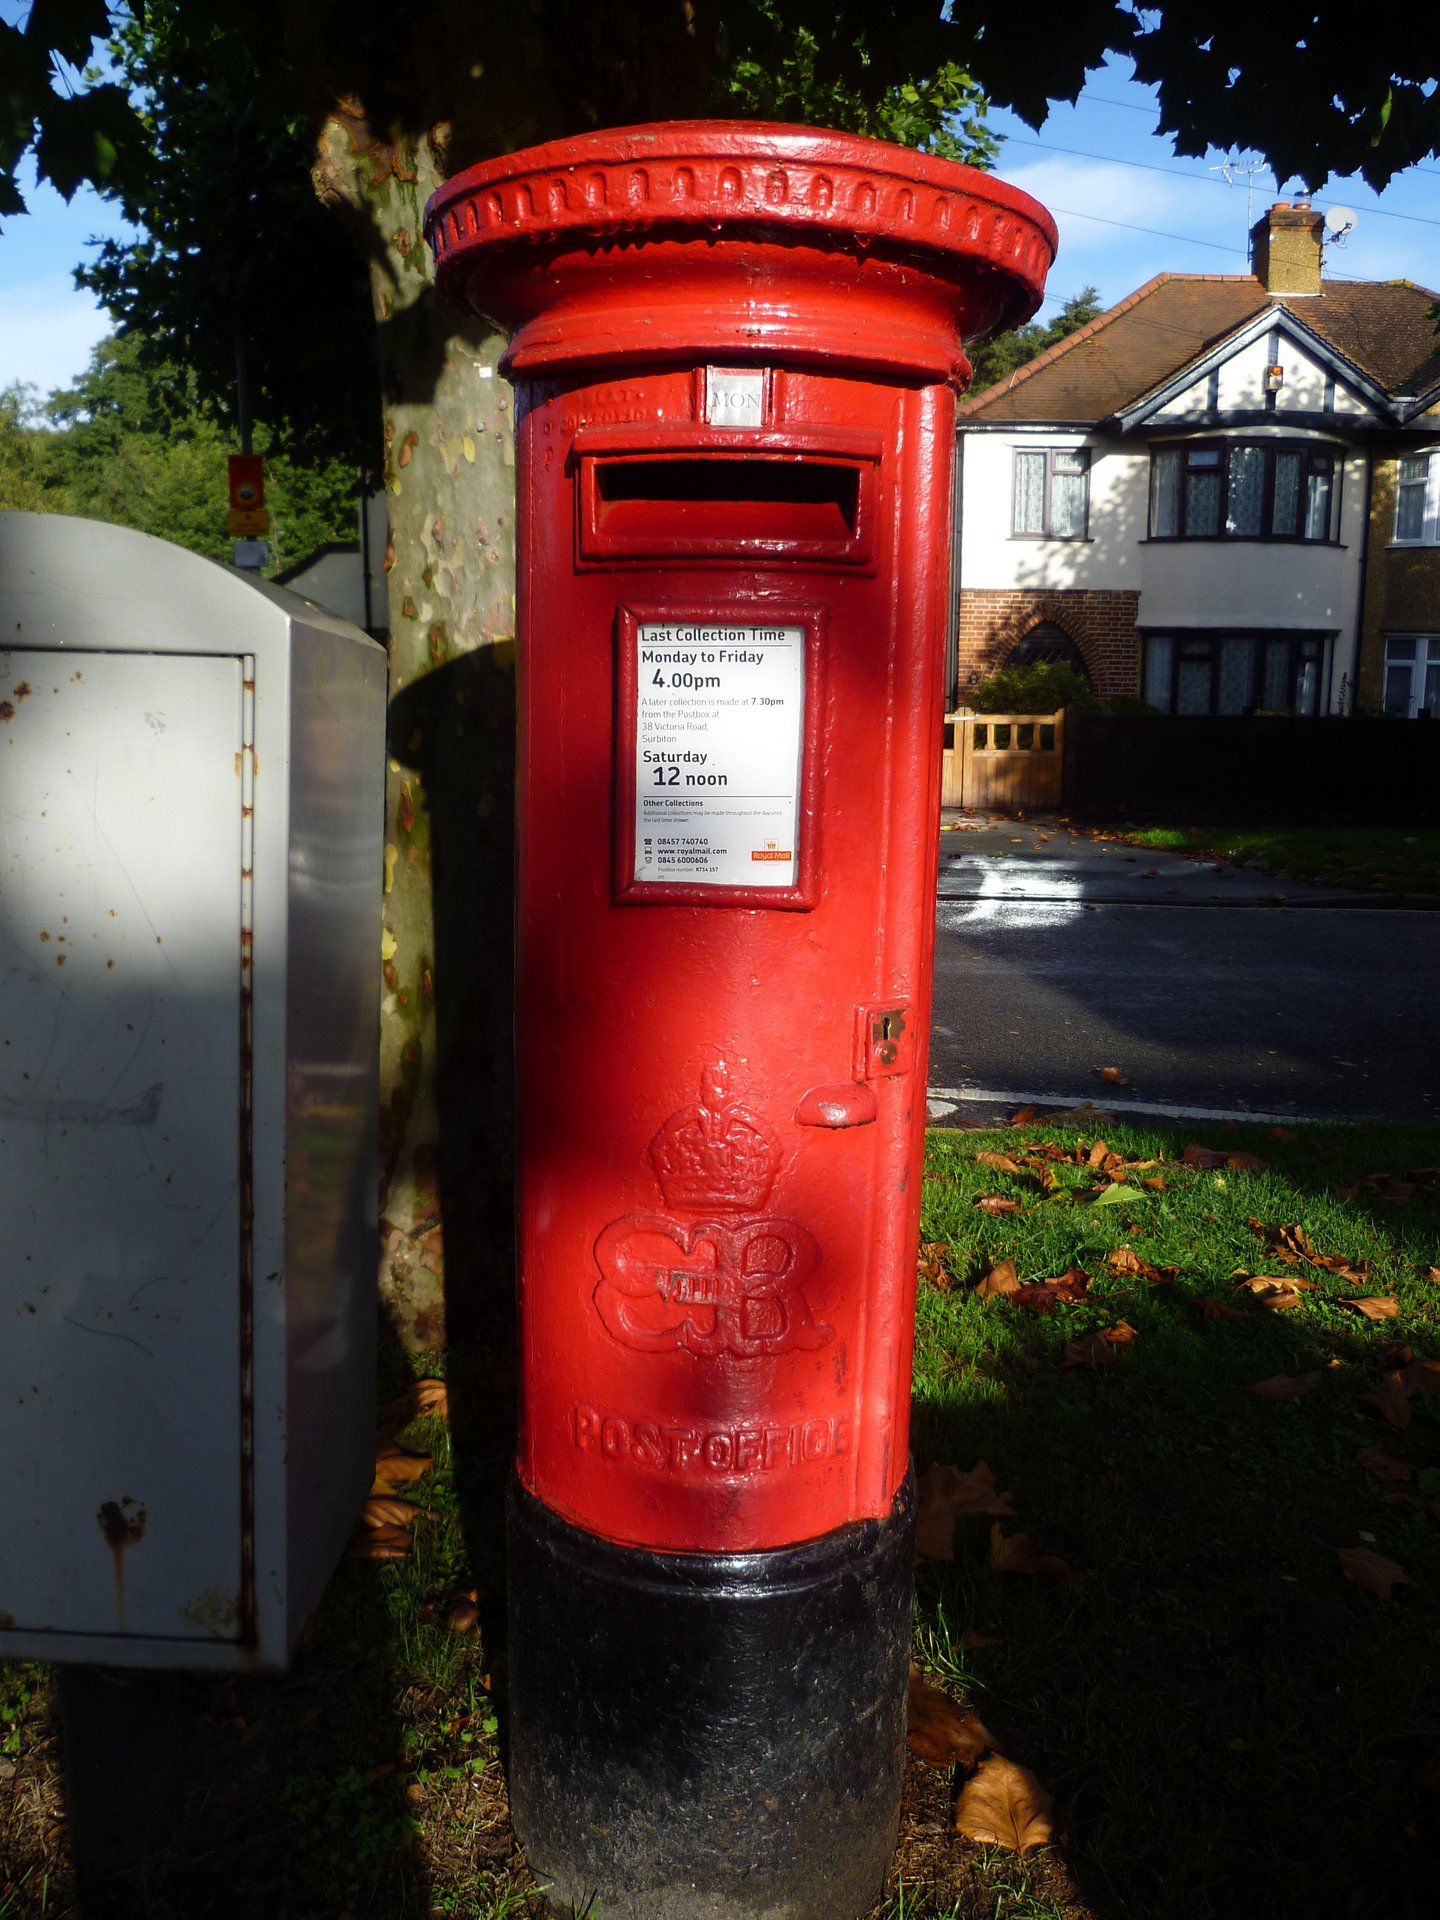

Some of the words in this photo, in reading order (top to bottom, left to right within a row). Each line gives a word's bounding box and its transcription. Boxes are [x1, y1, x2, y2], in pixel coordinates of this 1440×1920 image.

[711, 392, 762, 409] MON
[641, 628, 673, 642] Last
[676, 628, 746, 642] Collection
[749, 627, 786, 641] Time
[642, 650, 698, 665] Monday
[701, 652, 715, 663] to
[719, 650, 764, 665] Friday
[652, 668, 721, 691] 4.00pm
[641, 698, 649, 706] A
[649, 698, 667, 706] later
[669, 698, 707, 706] collection
[708, 698, 715, 706] is
[717, 698, 740, 706] made
[740, 698, 750, 706] at
[751, 697, 784, 707] 7.30pm
[641, 710, 662, 719] from
[663, 710, 676, 719] the
[677, 710, 710, 719] Postbox
[642, 722, 653, 731] 38
[654, 722, 685, 731] Victoria
[686, 722, 710, 732] Road,
[642, 735, 677, 743] Surbiton
[643, 750, 708, 766] Saturday
[652, 766, 681, 786] 12
[686, 774, 728, 786] noon
[643, 799, 663, 807] Other
[664, 799, 704, 807] Collections
[657, 847, 728, 856] www.royalmail.com
[753, 852, 774, 860] Royal
[574, 1401, 700, 1471] POST
[699, 1415, 851, 1472] OFFICE
